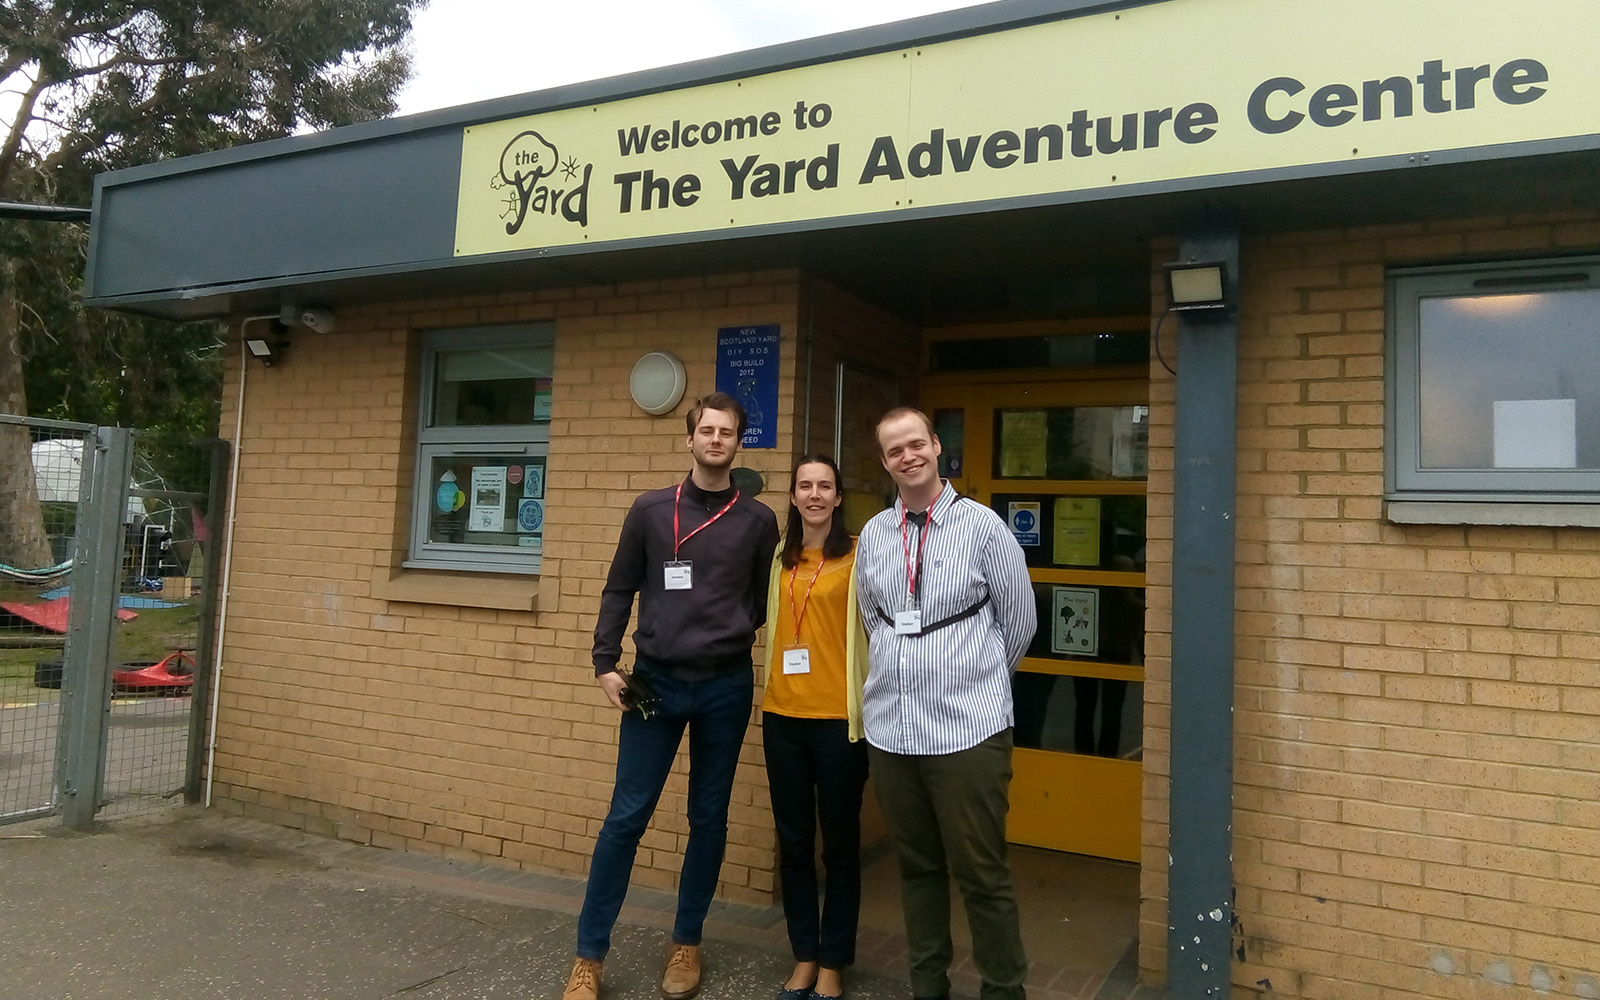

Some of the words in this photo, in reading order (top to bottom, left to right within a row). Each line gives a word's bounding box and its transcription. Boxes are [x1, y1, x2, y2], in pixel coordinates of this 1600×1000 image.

[617, 111, 781, 158] Welcome
[793, 100, 833, 131] to
[613, 170, 702, 214] The
[719, 143, 840, 201] Yard
[858, 102, 1219, 185] Adventure
[1247, 59, 1549, 135] Centre
[514, 149, 540, 167] the
[740, 328, 757, 336] NEW
[720, 337, 757, 347] SCOTLAND
[758, 335, 778, 343] YARD
[730, 360, 743, 368] BIG
[743, 358, 765, 367] BUILD
[739, 368, 755, 377] 2012
[741, 436, 759, 444] EED
